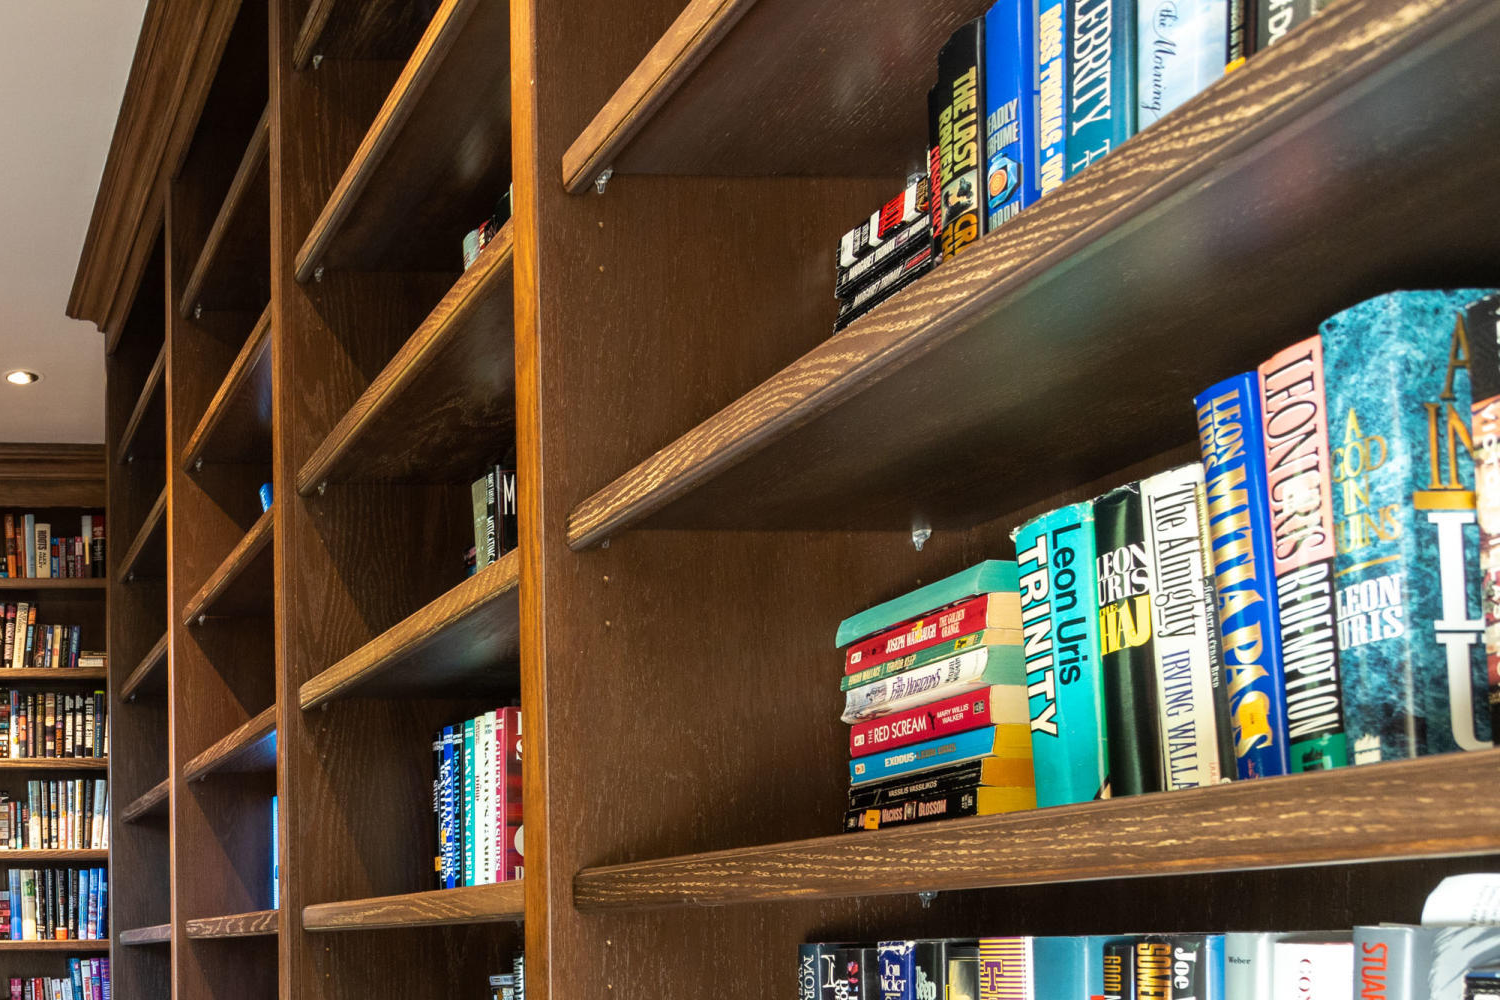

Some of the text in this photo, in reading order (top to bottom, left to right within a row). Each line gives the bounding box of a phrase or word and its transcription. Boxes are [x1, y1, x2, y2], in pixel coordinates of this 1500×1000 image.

[1040, 3, 1063, 150] ROSS THOMAS
[953, 66, 977, 173] THE LAST
[1212, 389, 1246, 465] LEON
[1052, 523, 1089, 686] Leon Uris
[1336, 573, 1403, 621] LEON
[885, 635, 906, 654] JOSEPH
[1017, 533, 1059, 738] TRINITY
[1099, 594, 1152, 657] HAJ
[1336, 606, 1405, 651] URIS
[1276, 562, 1341, 739] REDEMPTION
[1162, 648, 1195, 716] IRVING
[874, 714, 927, 744] RED SCREAM
[942, 712, 964, 725] WALKER
[951, 703, 969, 715] WILLIS
[884, 752, 915, 768] EXODUS
[918, 799, 948, 818] BLOSSOM
[1104, 955, 1122, 992] GOOD
[1228, 956, 1252, 965] Weber
